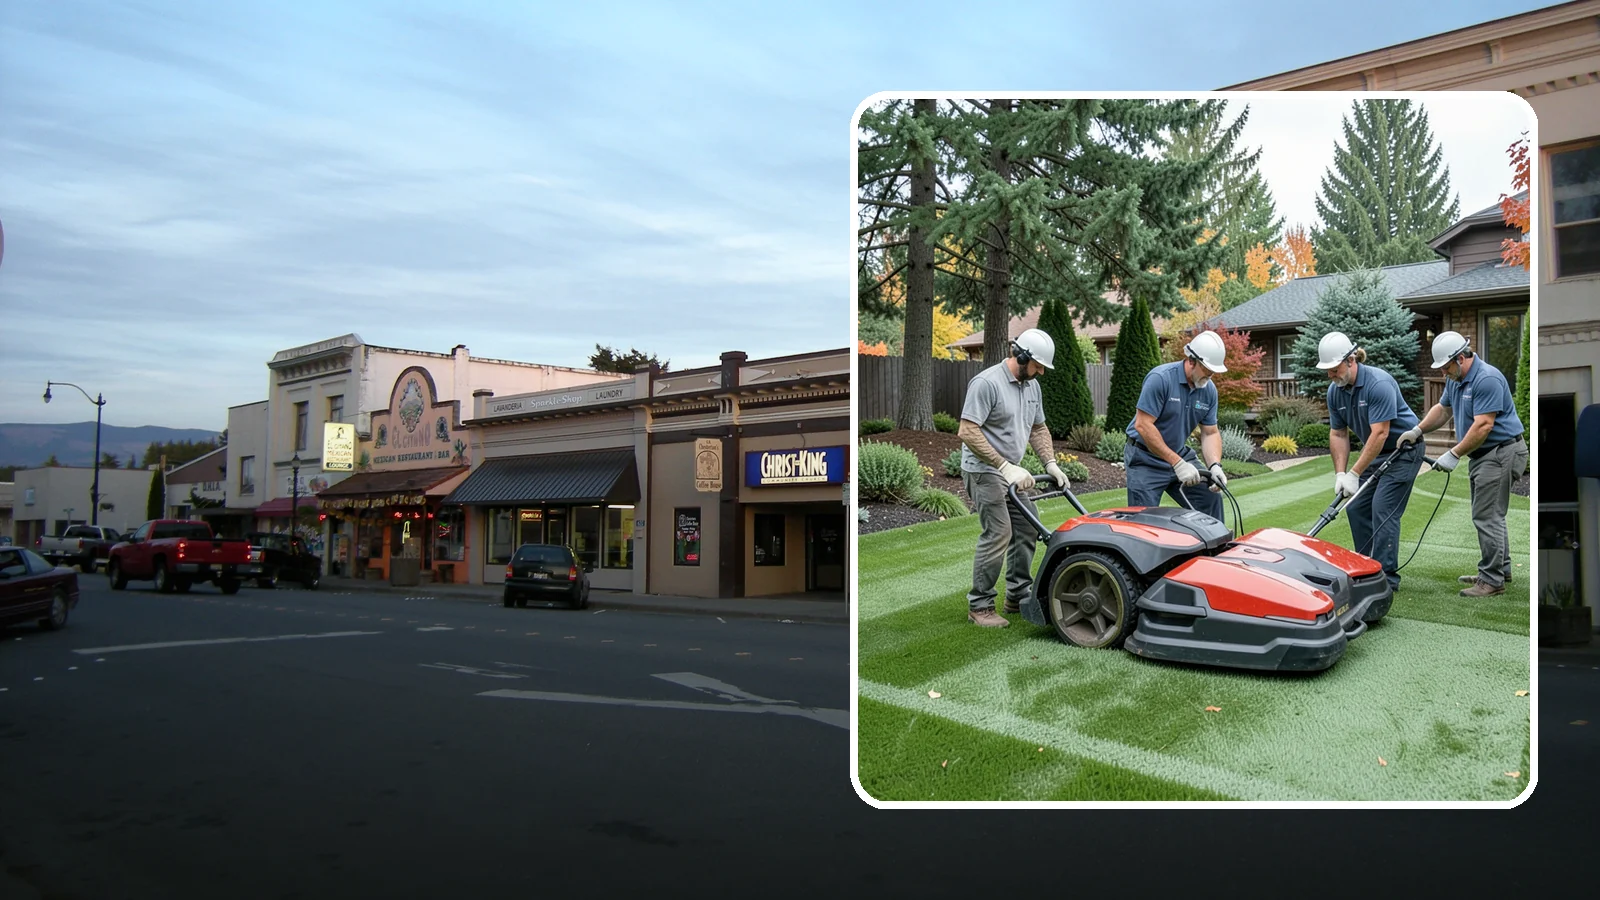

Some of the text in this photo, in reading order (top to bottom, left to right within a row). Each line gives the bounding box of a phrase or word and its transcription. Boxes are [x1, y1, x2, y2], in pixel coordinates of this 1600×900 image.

[493, 402, 522, 413] LAVANDERIA
[595, 389, 623, 400] LAUNDRY
[391, 425, 401, 449] EL
[373, 455, 396, 464] MEXICAN
[397, 451, 433, 463] RESTAURANT
[438, 450, 450, 459] BAR
[760, 450, 827, 478] CHRIST KING
